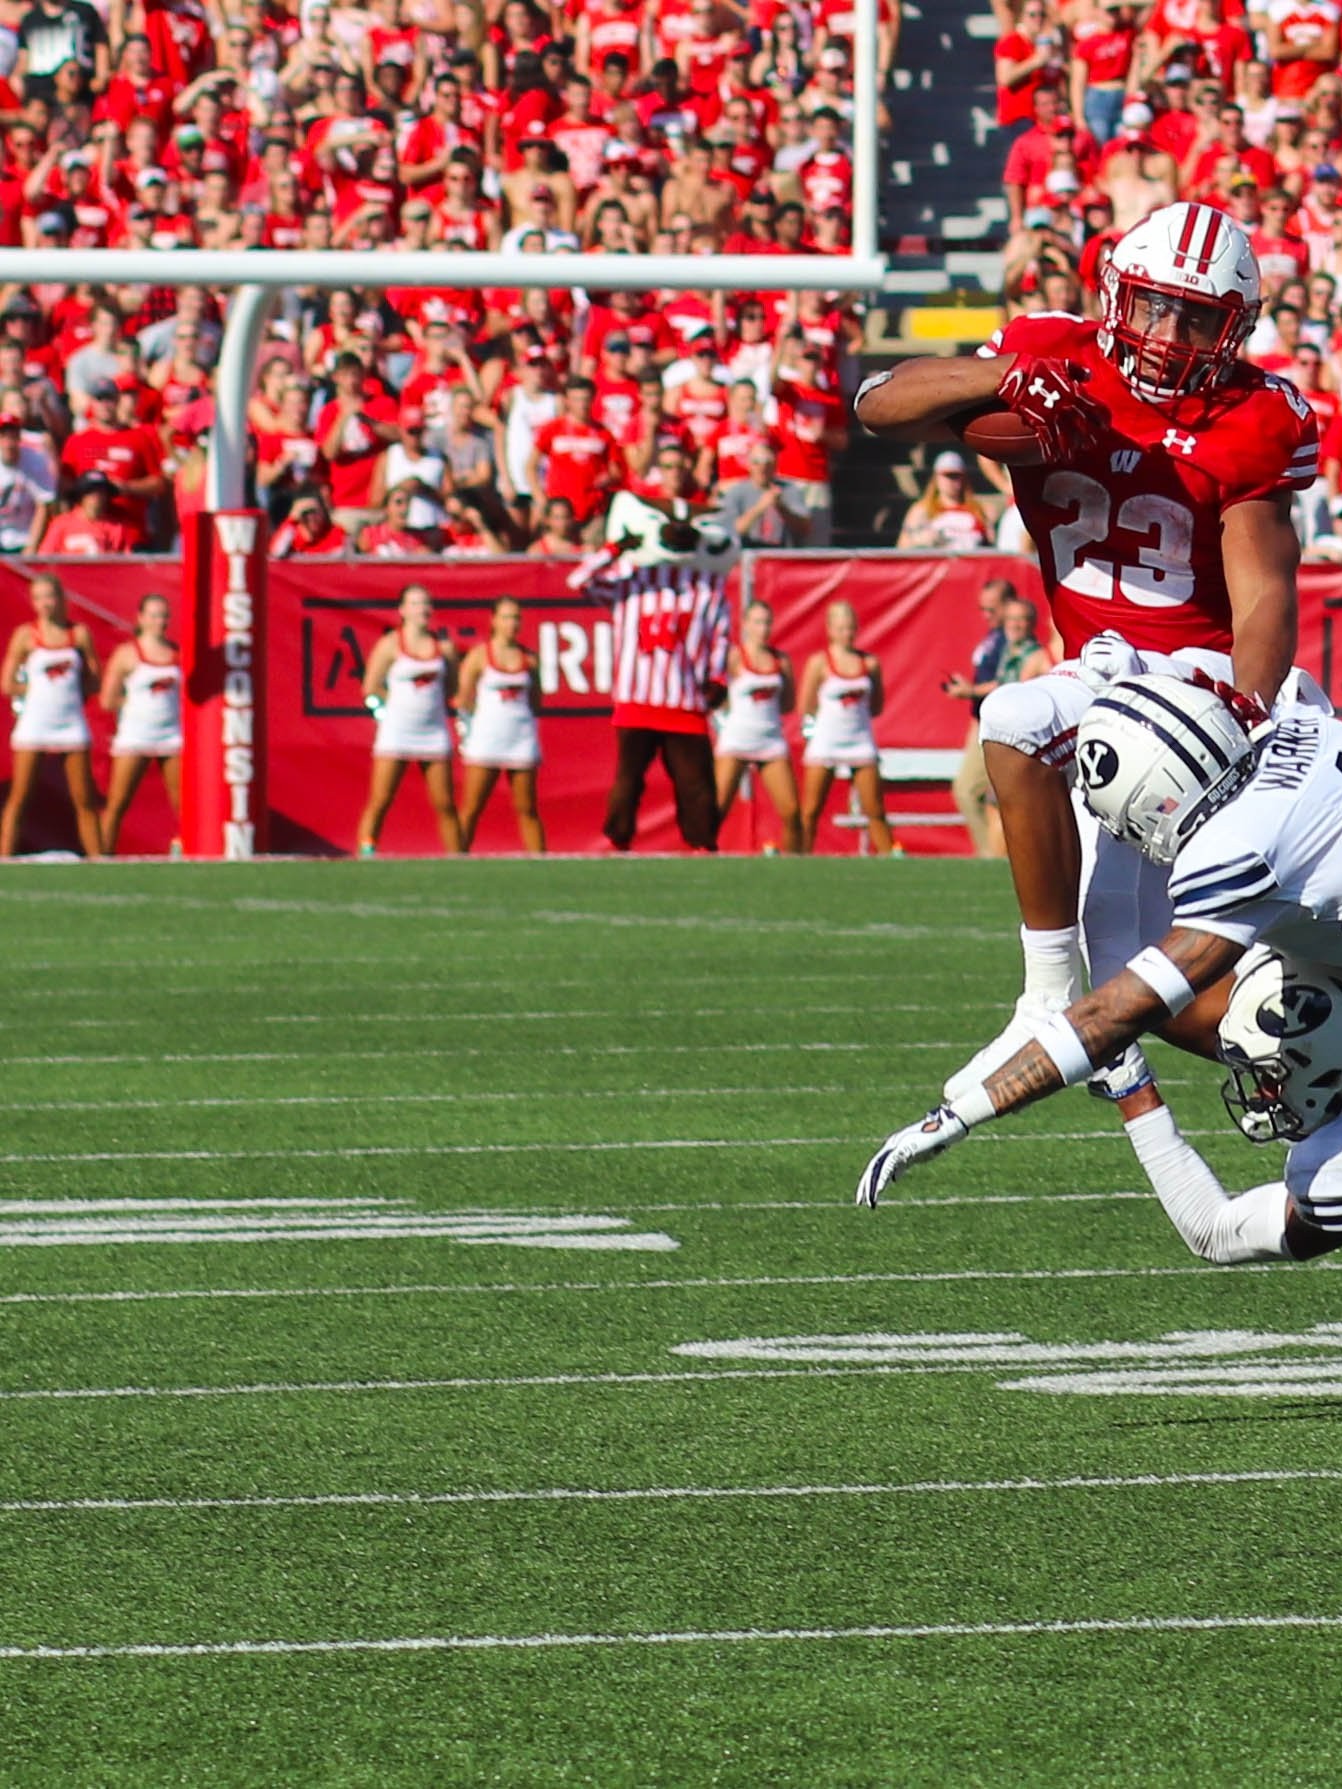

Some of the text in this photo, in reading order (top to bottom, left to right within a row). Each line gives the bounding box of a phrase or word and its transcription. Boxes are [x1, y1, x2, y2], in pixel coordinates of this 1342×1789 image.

[1110, 450, 1142, 474] W
[1043, 471, 1196, 608] 23
[214, 515, 255, 861] WISCONSIN
